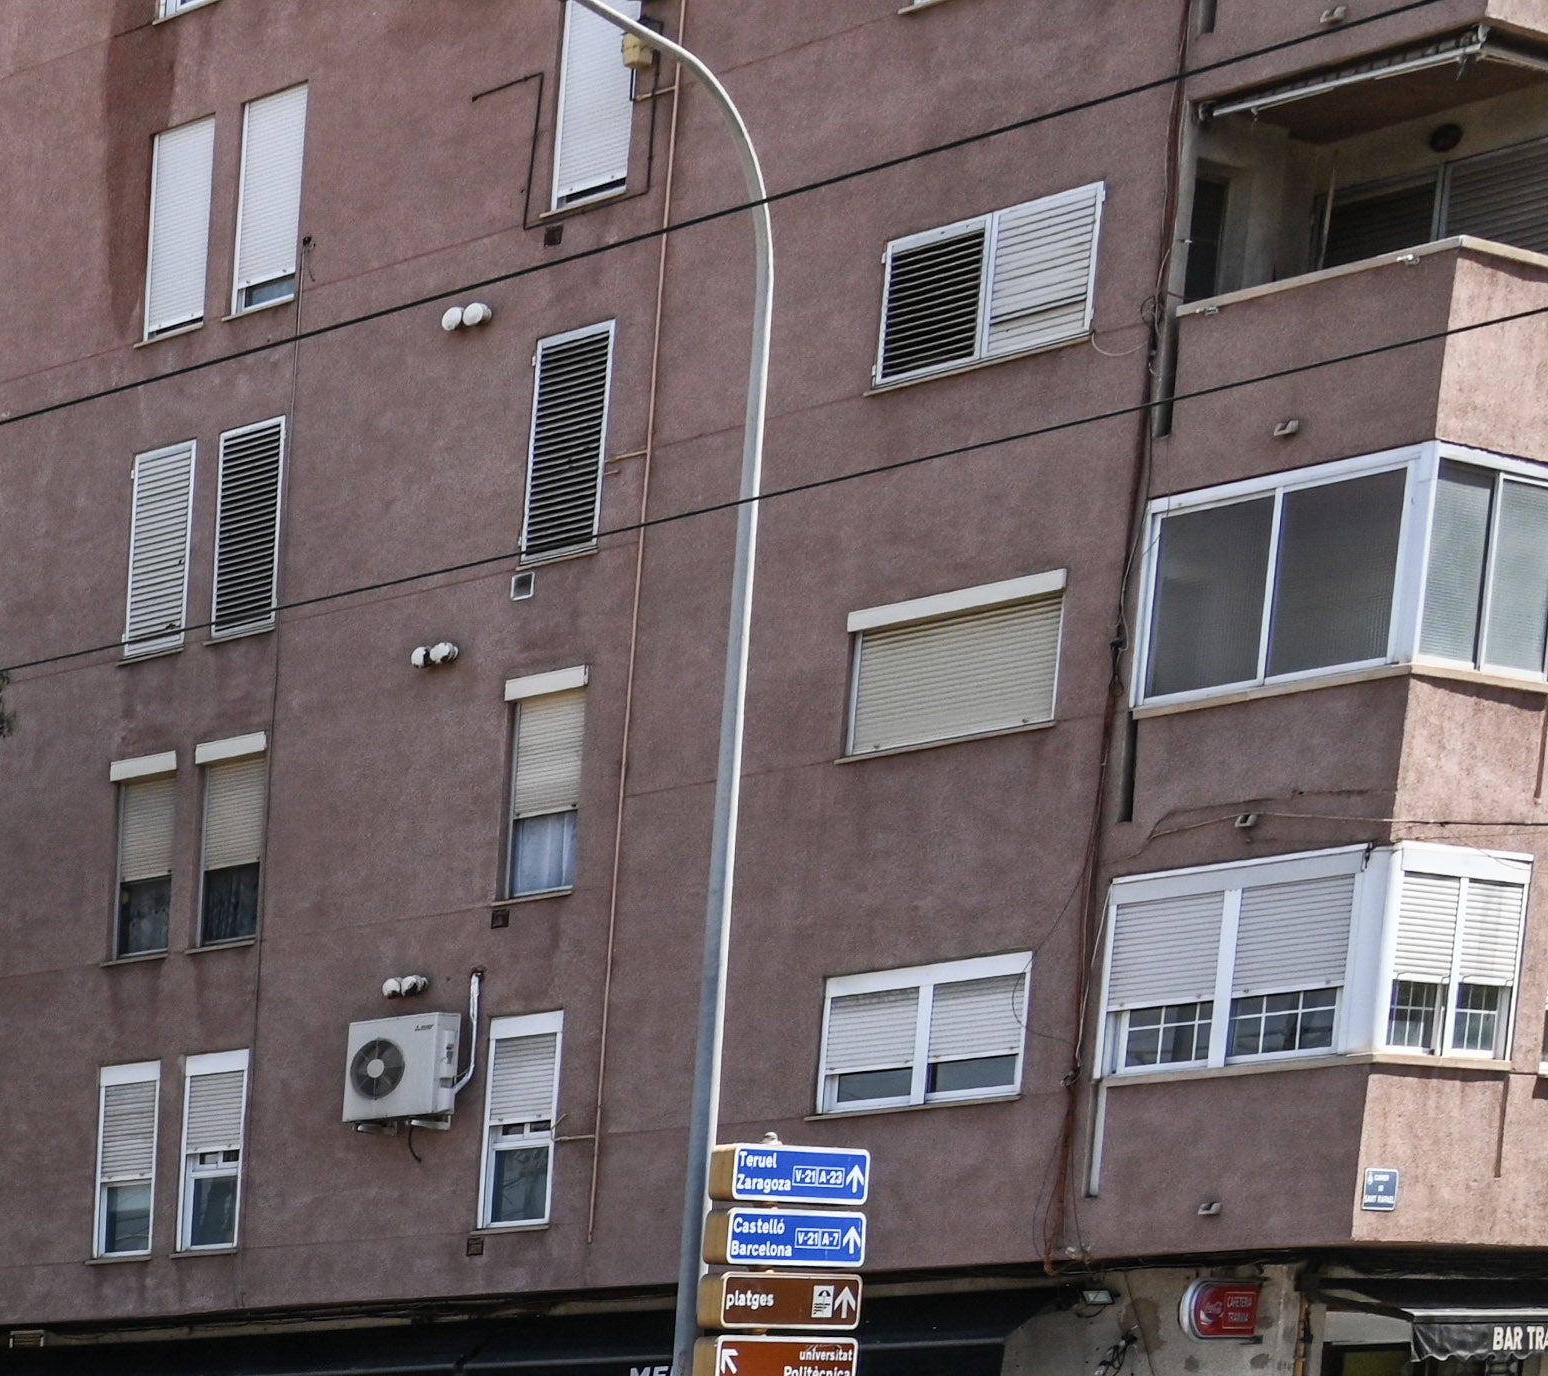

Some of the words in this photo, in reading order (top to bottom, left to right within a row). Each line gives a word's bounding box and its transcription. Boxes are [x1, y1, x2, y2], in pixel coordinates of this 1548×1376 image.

[739, 1151, 778, 1168] Teruel
[736, 1174, 792, 1194] Zaragoza
[795, 1169, 816, 1183] V-21
[819, 1170, 843, 1185] A-23
[733, 1217, 786, 1235] Castelló
[797, 1231, 819, 1245] V-21
[821, 1232, 839, 1246] A-7
[730, 1240, 793, 1257] Barcelona
[725, 1289, 775, 1310] platges
[1492, 1326, 1524, 1351] BAR
